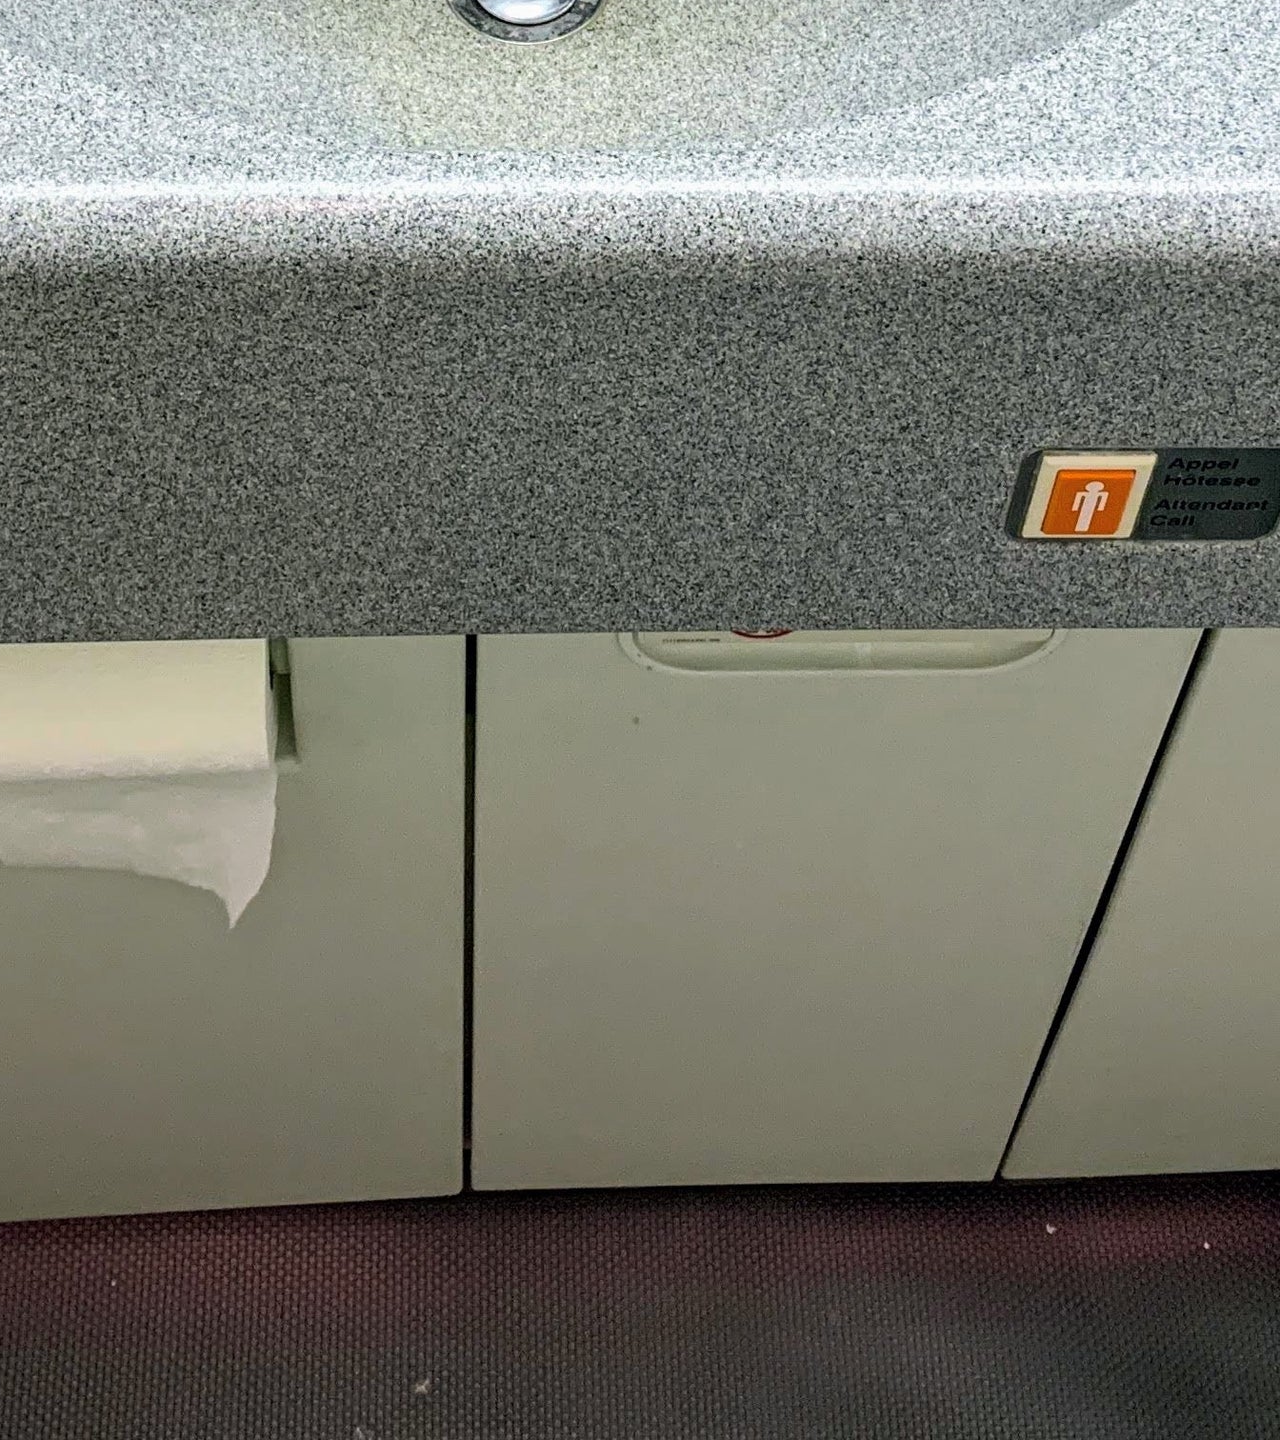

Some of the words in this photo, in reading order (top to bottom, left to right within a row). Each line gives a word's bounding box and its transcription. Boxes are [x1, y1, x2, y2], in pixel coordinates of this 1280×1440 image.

[1167, 457, 1240, 472] Appel
[1154, 498, 1269, 511] Attendant
[1149, 515, 1195, 527] Call
